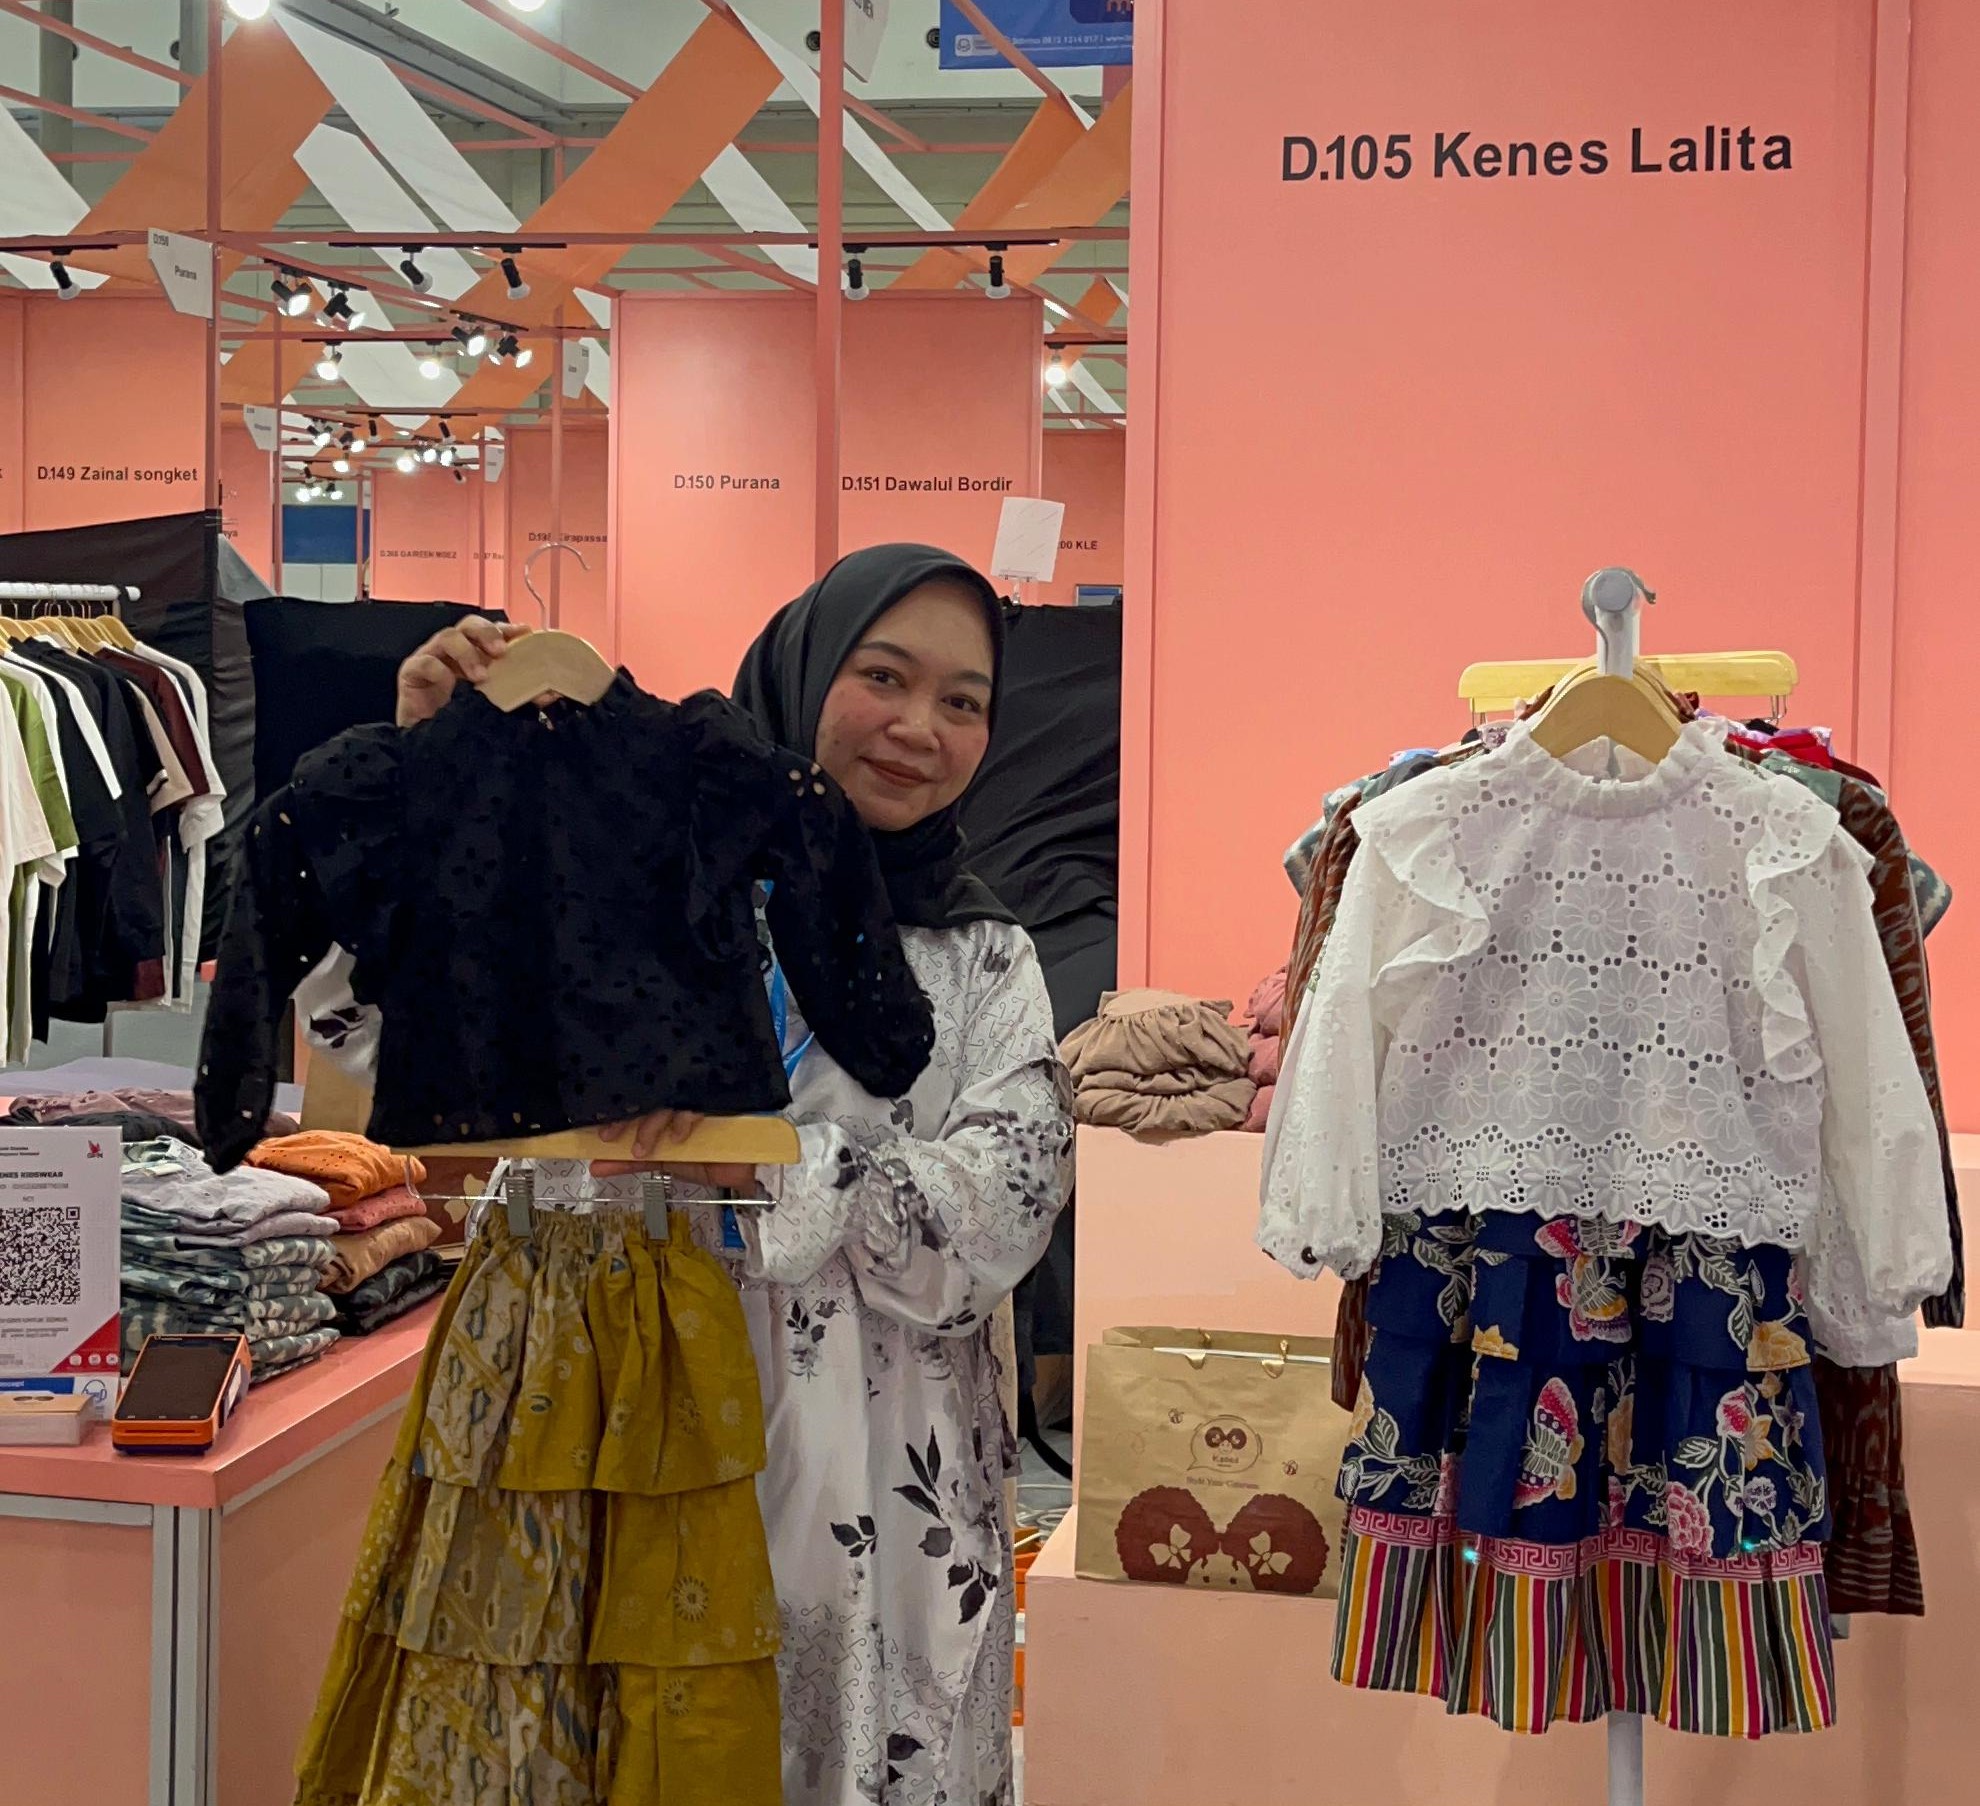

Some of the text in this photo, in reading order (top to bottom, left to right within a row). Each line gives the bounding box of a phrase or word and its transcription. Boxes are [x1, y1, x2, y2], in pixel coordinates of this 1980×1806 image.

[1283, 126, 1791, 180] D.105 Kenes Lalita
[38, 467, 196, 484] D.149 Zainal songket
[675, 475, 779, 489] D.150 Purana
[843, 477, 1012, 490] D.151 Dawalul Bordir
[1060, 540, 1098, 549] 00 KLE
